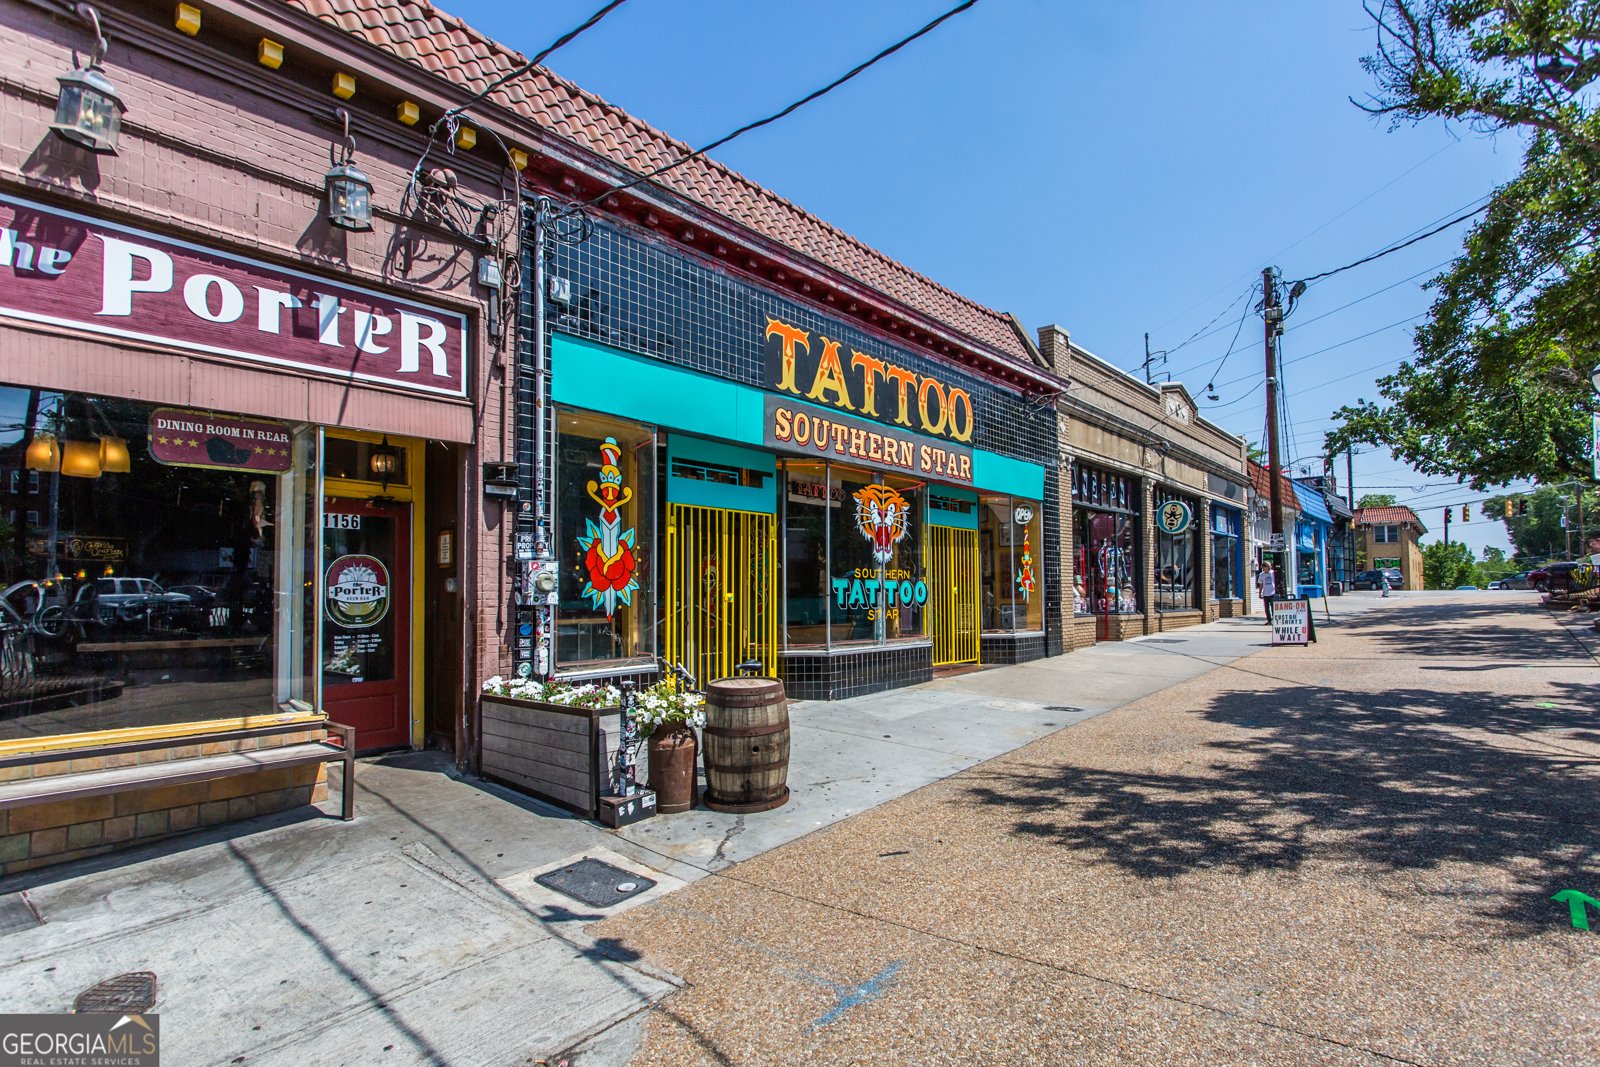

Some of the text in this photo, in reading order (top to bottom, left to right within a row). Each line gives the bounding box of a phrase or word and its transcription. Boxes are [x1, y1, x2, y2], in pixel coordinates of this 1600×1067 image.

[765, 315, 974, 444] TATTOO
[157, 418, 289, 443] DINING ROOM IN REAR
[775, 406, 973, 482] SOUTHERN STAR
[795, 481, 846, 501] TATTOO
[323, 513, 359, 529] 1156
[1016, 507, 1032, 521] OPEN
[853, 567, 911, 579] SOUTHERN
[832, 578, 928, 610] TATTOO
[1274, 602, 1306, 611] BANG-ON
[867, 609, 899, 621] STAR
[1275, 626, 1307, 635] WHILE U
[1280, 633, 1302, 641] WAIT
